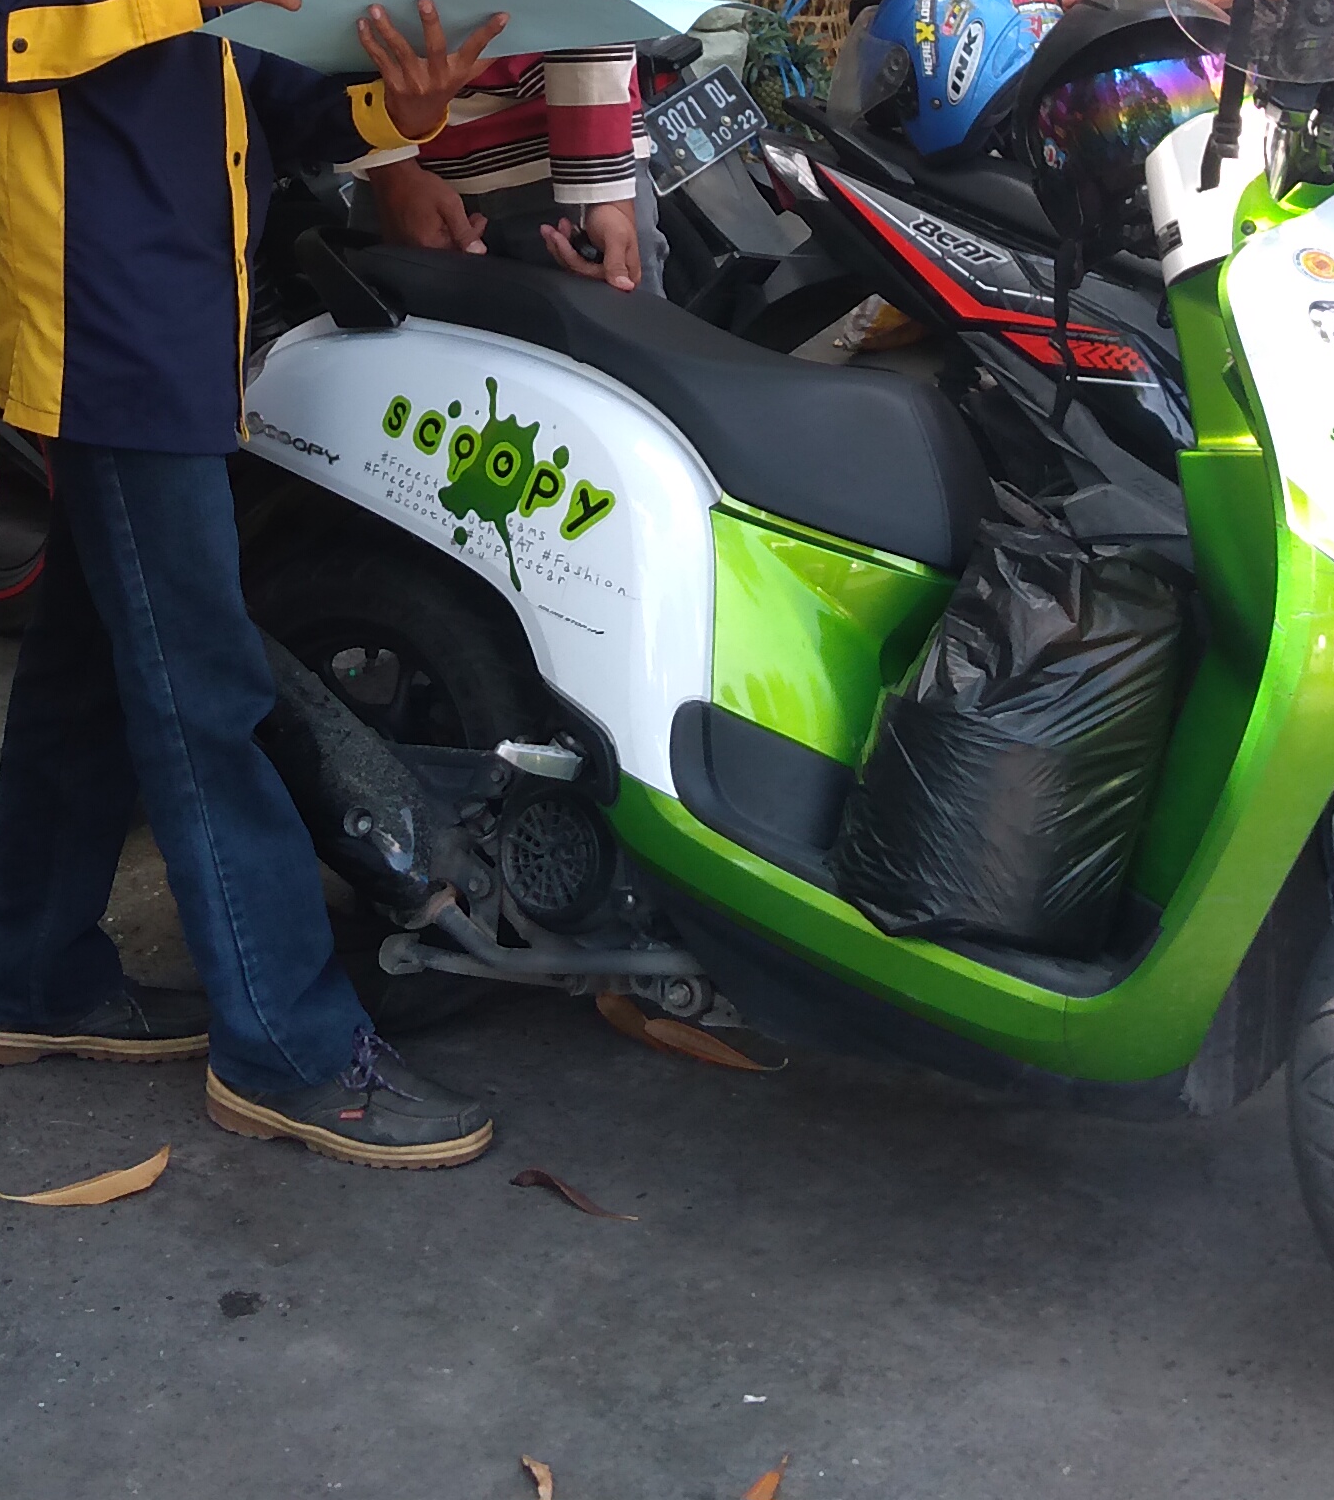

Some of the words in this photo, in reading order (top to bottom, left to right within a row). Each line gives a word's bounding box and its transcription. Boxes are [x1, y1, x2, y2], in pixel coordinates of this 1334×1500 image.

[951, 27, 980, 96] INK
[657, 95, 707, 141] 3071
[380, 451, 439, 489] #Freest
[542, 548, 627, 597] #Fashion
